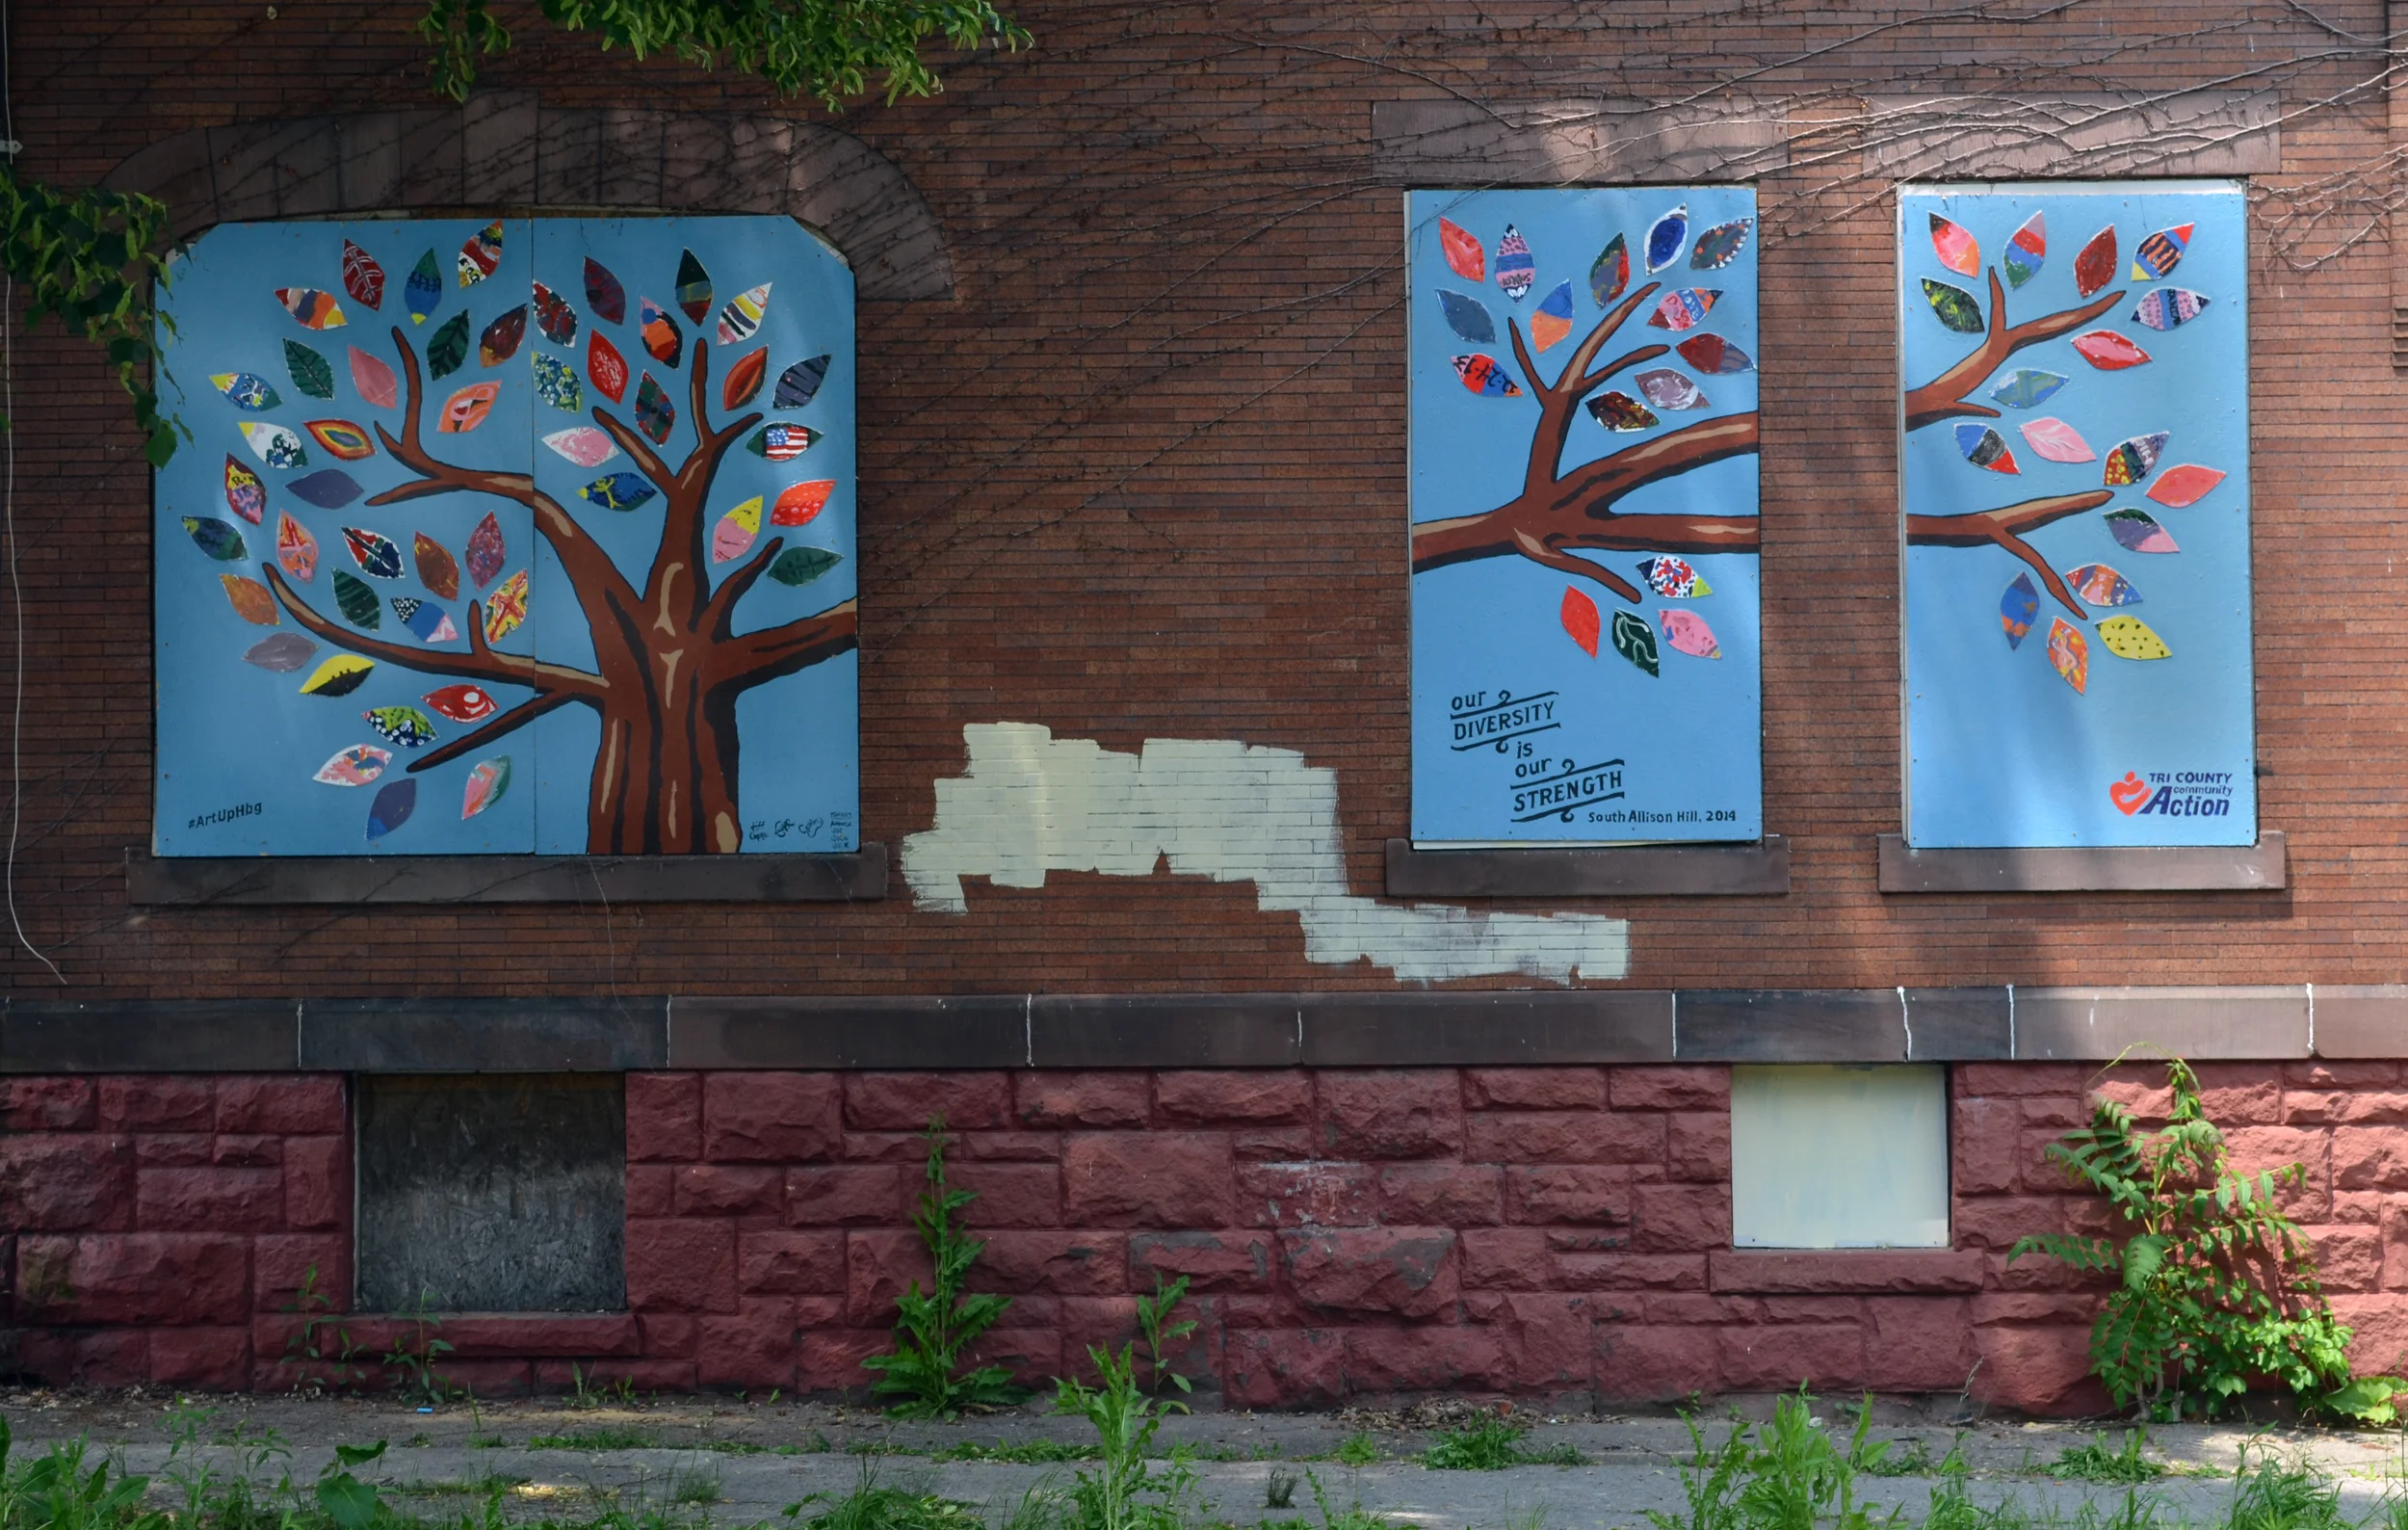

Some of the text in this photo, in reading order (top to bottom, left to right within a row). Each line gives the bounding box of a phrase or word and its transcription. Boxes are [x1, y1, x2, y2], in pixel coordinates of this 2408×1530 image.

[1451, 690, 1486, 711] our
[1453, 700, 1555, 741] DIVERSITY
[1516, 740, 1533, 758] is
[1514, 757, 1553, 778] our
[2149, 772, 2233, 784] TRI COUNTY
[1512, 771, 1623, 812] STRENGTH
[2137, 785, 2230, 817] Action
[2173, 784, 2234, 797] community
[188, 802, 262, 830] #ArtUpHbg
[1588, 809, 1626, 823] South
[1628, 809, 1673, 823] Allison
[1705, 809, 1737, 822] 2014
